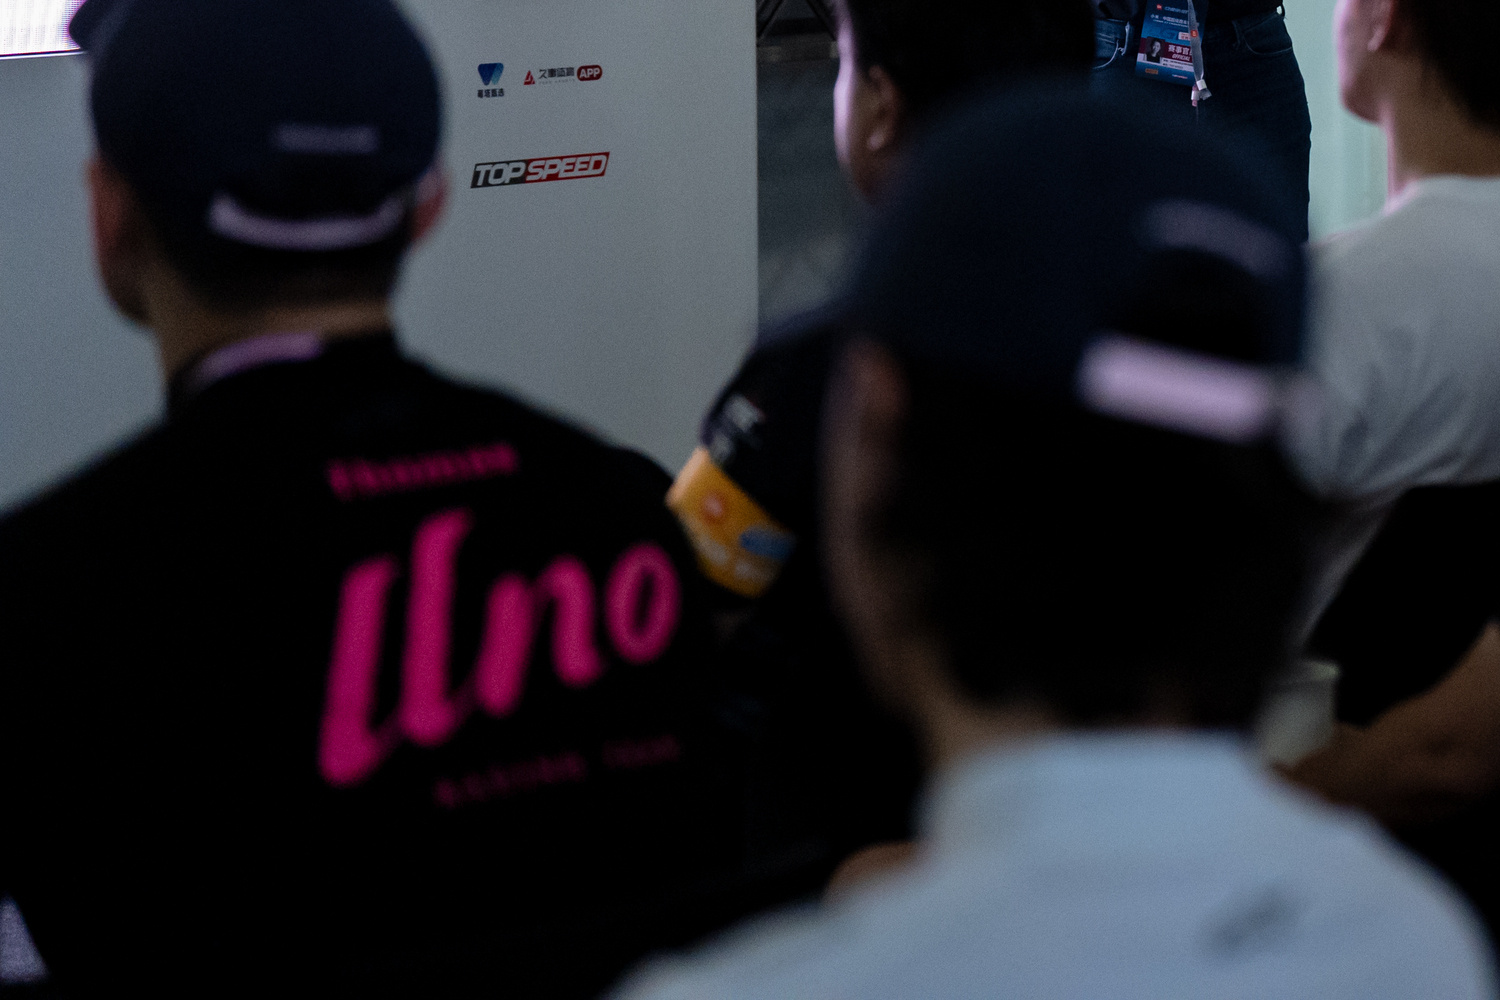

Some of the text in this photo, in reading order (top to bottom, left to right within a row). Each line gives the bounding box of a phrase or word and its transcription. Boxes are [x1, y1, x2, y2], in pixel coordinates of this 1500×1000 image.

[1168, 44, 1192, 56] 赛事官
[579, 67, 600, 79] APP
